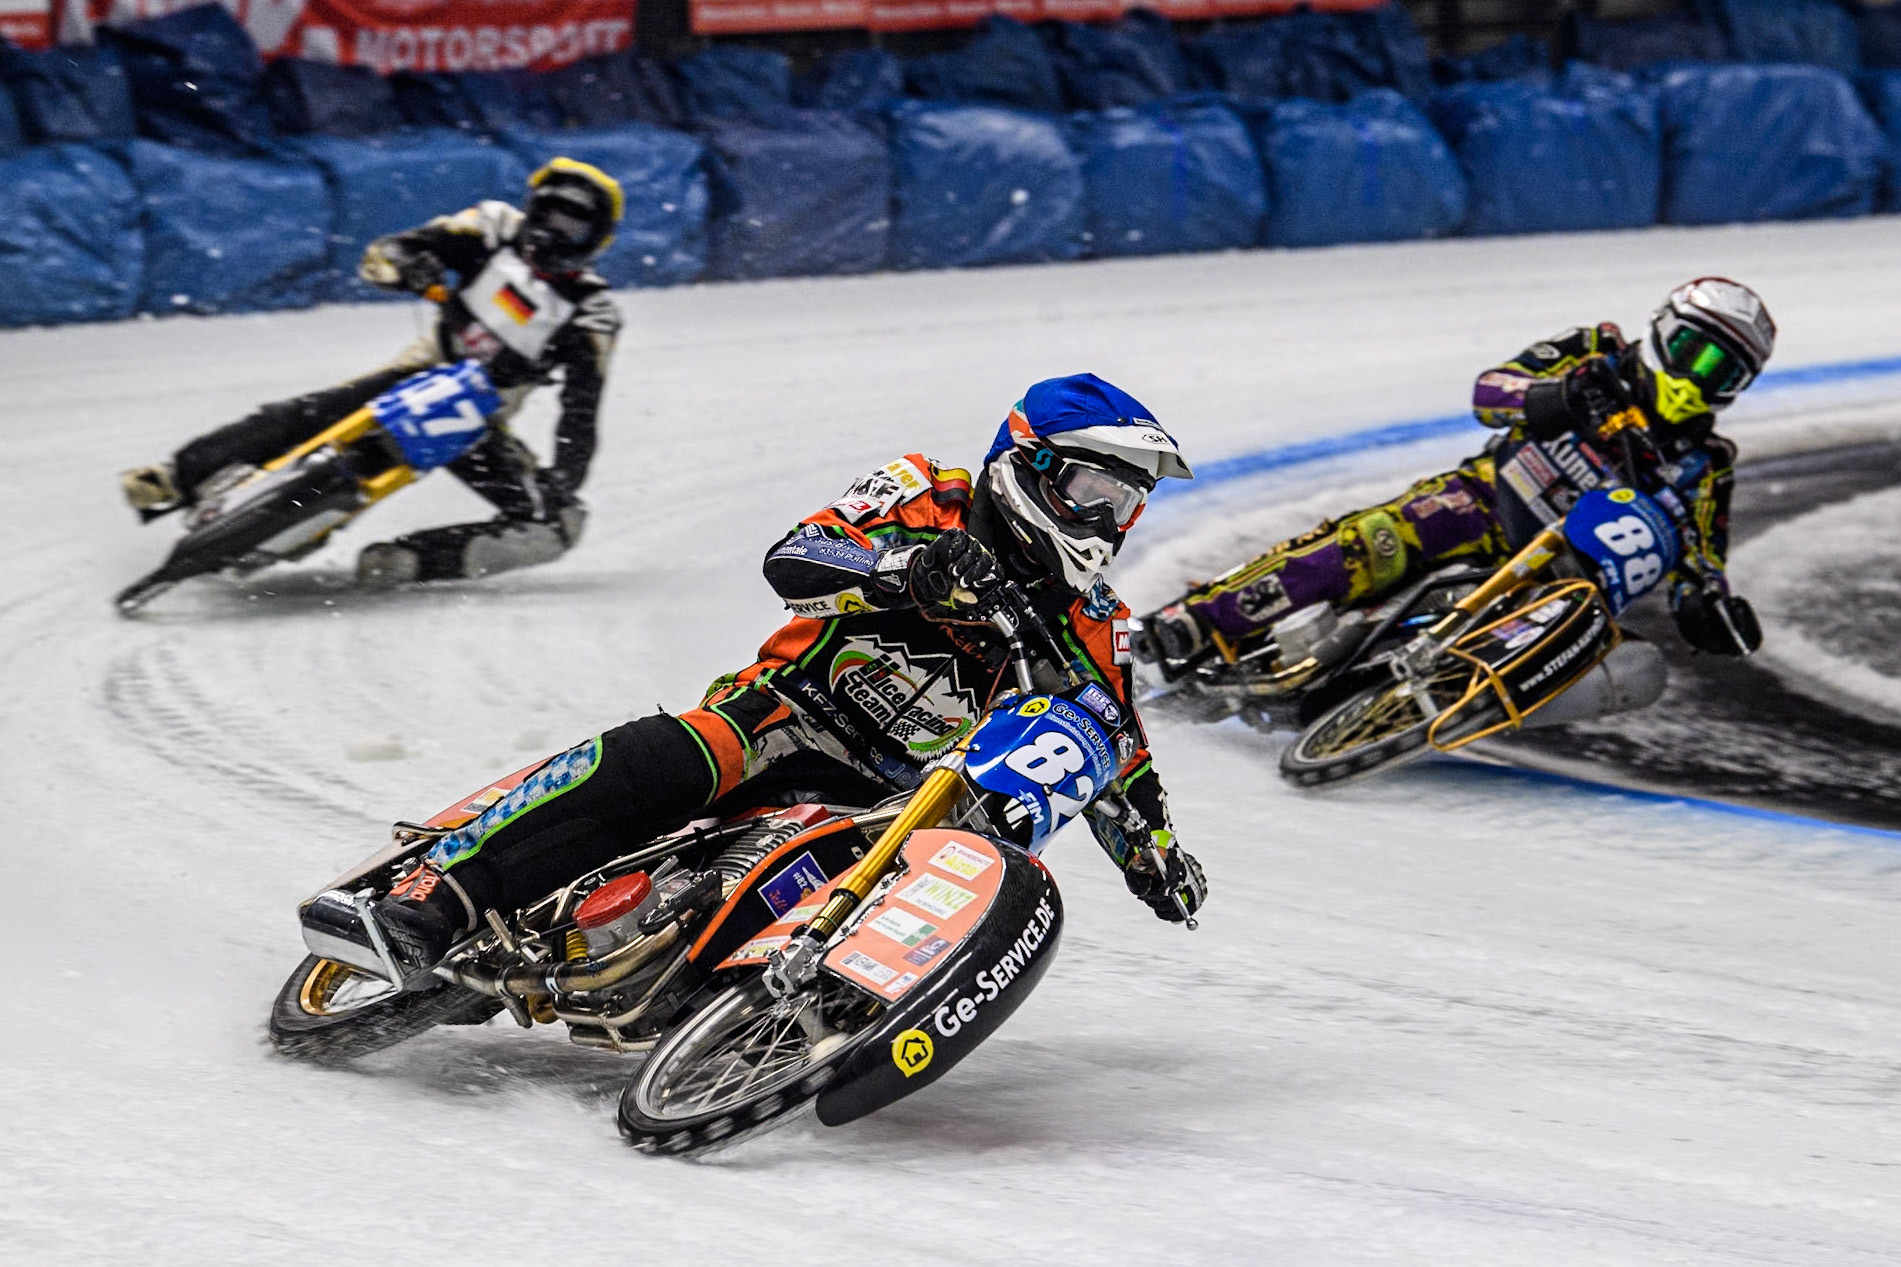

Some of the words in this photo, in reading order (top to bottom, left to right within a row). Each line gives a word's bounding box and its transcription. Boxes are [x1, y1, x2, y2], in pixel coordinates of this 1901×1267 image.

[356, 18, 630, 71] MOTORSPORT
[1593, 514, 1662, 596] 88
[801, 682, 884, 766] KFZ-Serce
[846, 670, 892, 723] team
[1004, 731, 1096, 836] 82
[1018, 788, 1045, 825] FIM
[933, 896, 1056, 1038] Ge-SERVICE.DE
